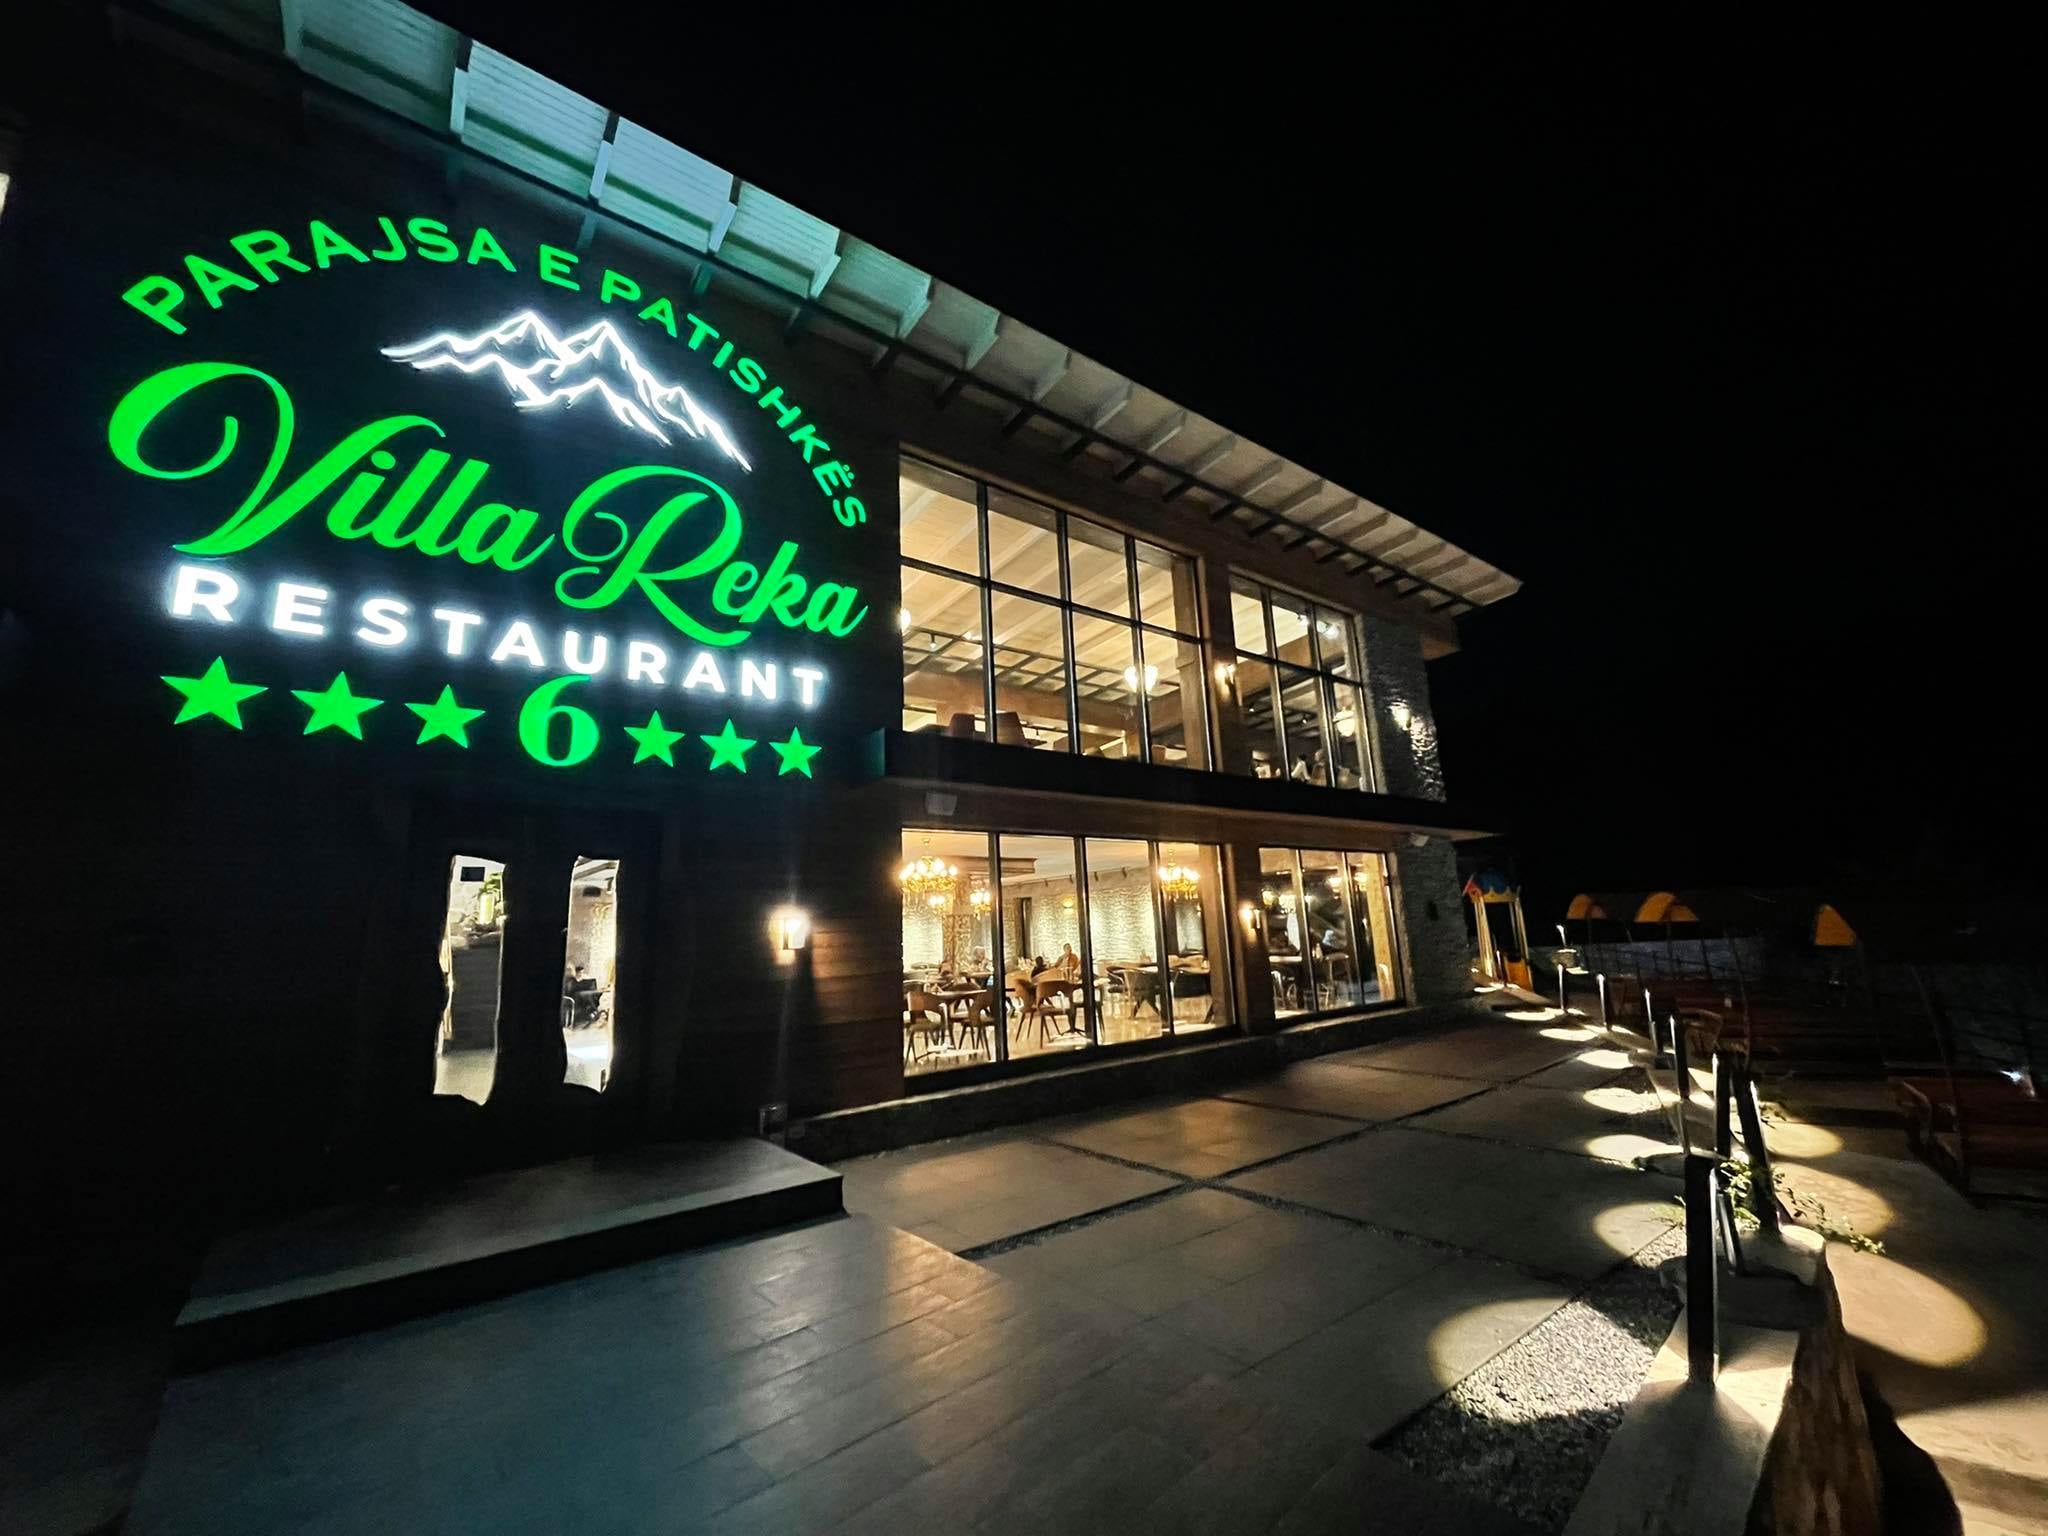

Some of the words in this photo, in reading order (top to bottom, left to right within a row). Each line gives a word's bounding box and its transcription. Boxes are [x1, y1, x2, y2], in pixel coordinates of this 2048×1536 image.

[121, 216, 516, 335] PARAJSA
[539, 243, 581, 292] E
[600, 268, 867, 529] PATISHKËS
[107, 361, 556, 572] Villa
[554, 464, 868, 649] Reka
[170, 564, 826, 707] RESTAURANT
[517, 673, 600, 768] 6
